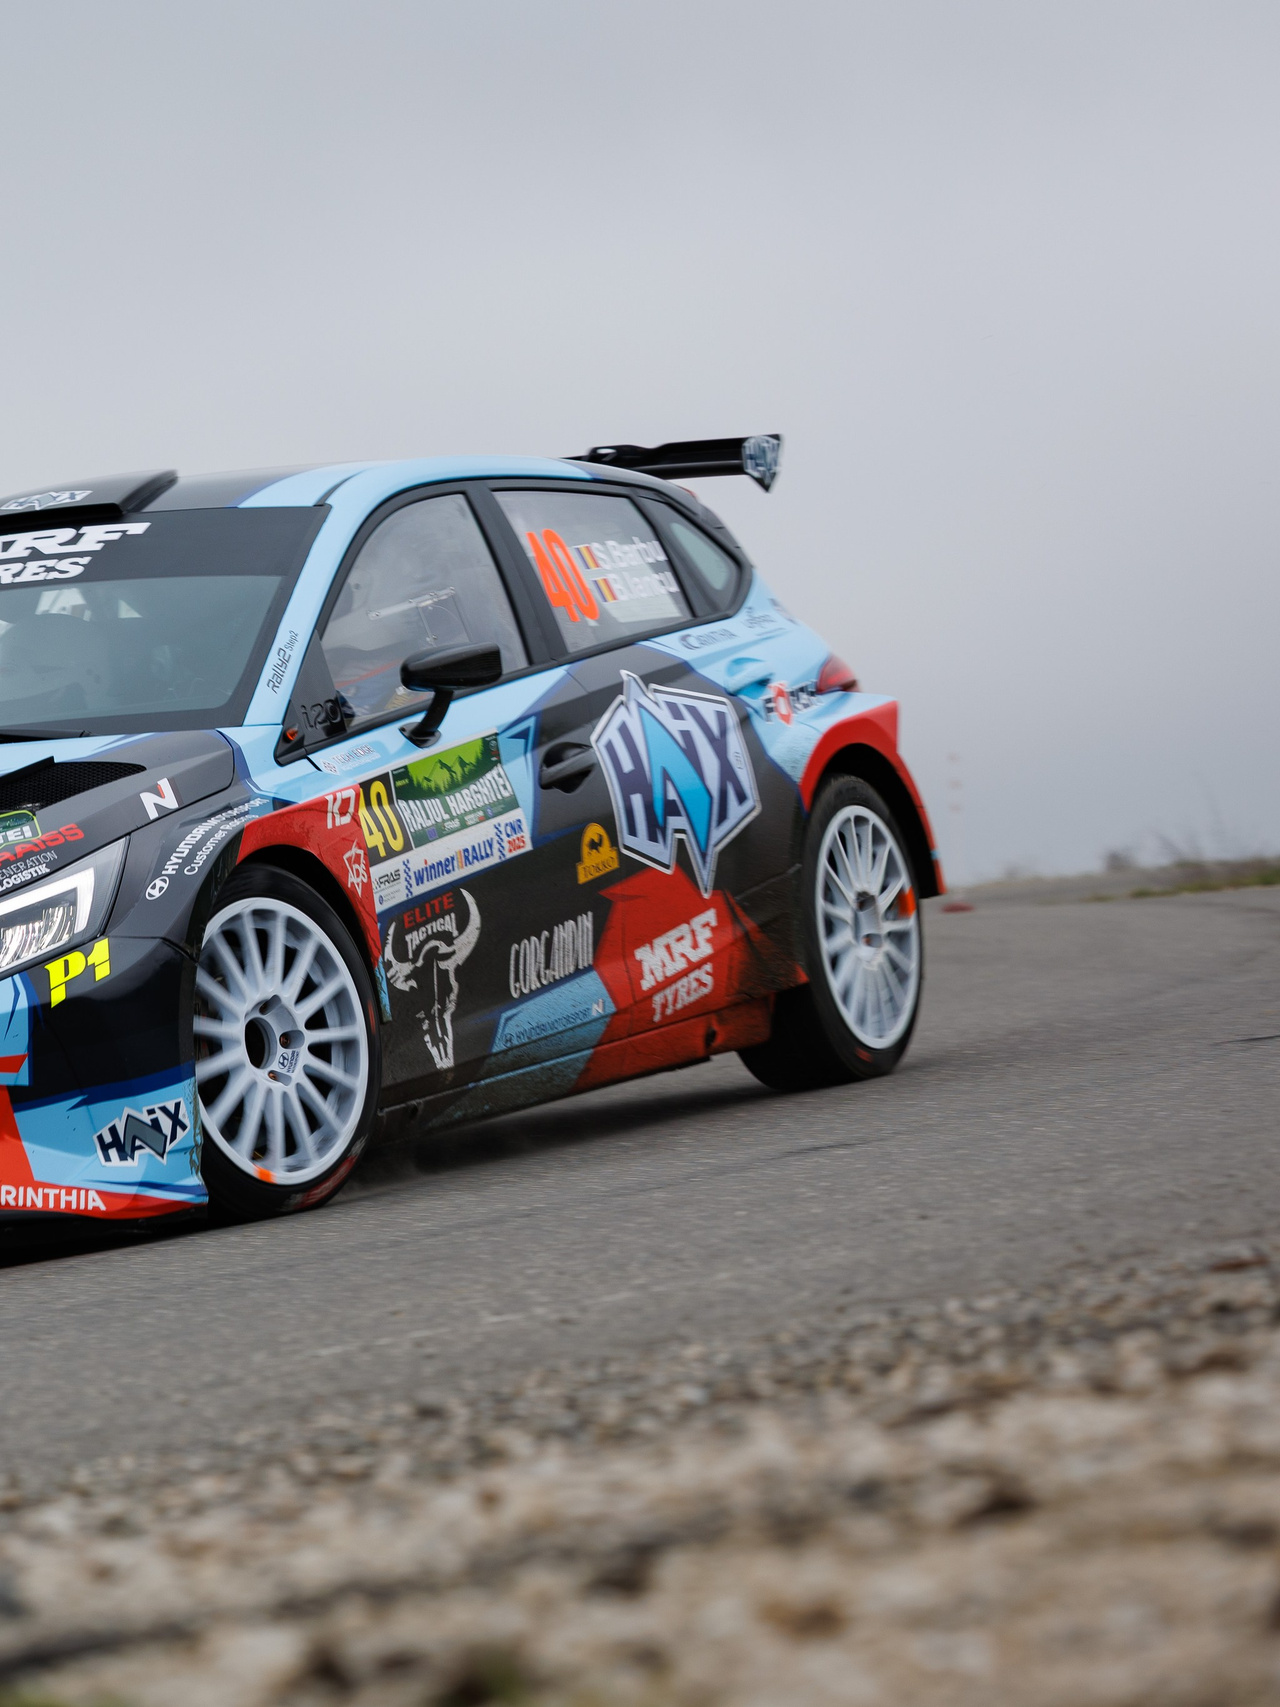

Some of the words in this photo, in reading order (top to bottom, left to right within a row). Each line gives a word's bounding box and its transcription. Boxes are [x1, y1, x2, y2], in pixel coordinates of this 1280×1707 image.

[526, 528, 601, 623] 40
[266, 647, 292, 695] Rally2
[301, 699, 339, 732] i20
[139, 777, 179, 820] N
[358, 780, 405, 858] 40
[398, 798, 451, 833] RALIUL
[445, 762, 514, 817] HARGHITEI
[162, 819, 216, 876] HYUNDAI
[183, 829, 228, 877] Customer
[413, 854, 457, 887] winner
[462, 837, 494, 867] RALLY
[403, 891, 456, 929] ELITE
[404, 911, 460, 960] TACTICAL
[43, 937, 112, 1009] P1
[633, 907, 718, 992] MRF
[651, 961, 715, 1023] TYRES
